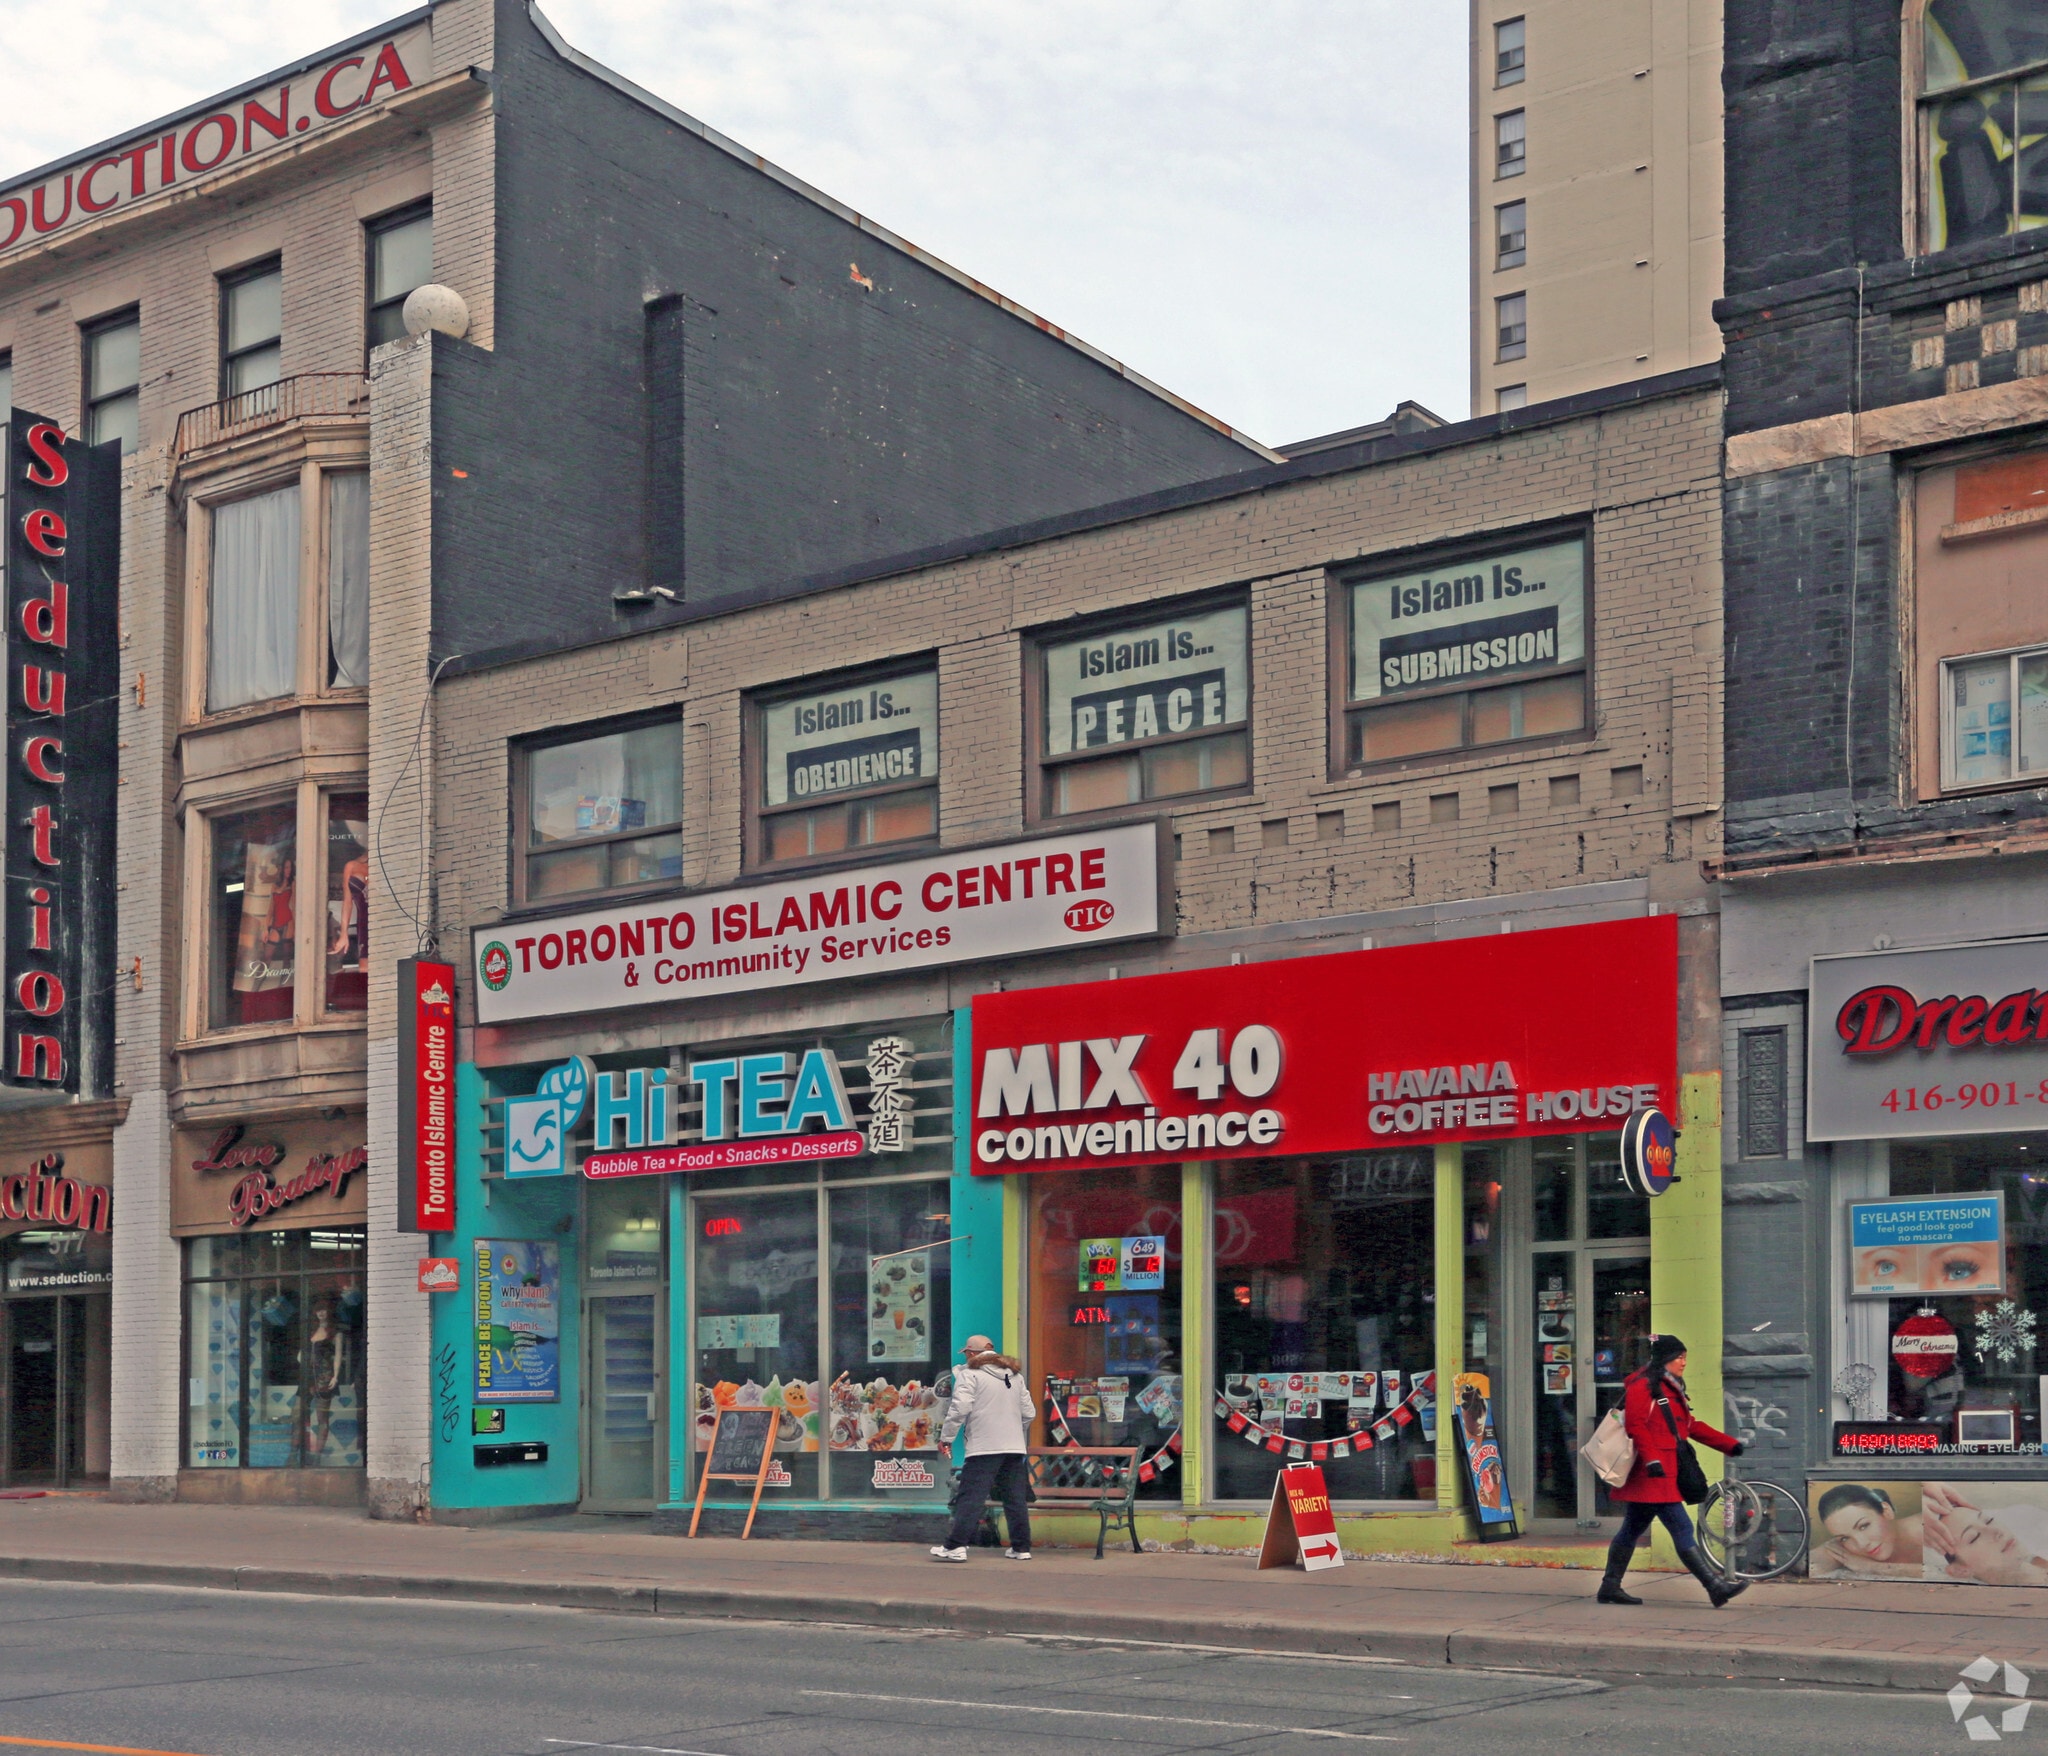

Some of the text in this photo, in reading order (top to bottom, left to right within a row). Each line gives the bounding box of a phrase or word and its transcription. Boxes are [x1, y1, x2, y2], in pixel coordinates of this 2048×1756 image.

[1391, 564, 1546, 620] Islam Is...
[1080, 629, 1214, 680] Islam Is...
[1383, 627, 1554, 687] SUBMISSION
[794, 691, 910, 736] Islam Is...
[1076, 681, 1222, 750] PEACE
[17, 423, 68, 1081] Seduction
[794, 747, 914, 795] OBEDIENCE
[515, 912, 695, 973] TORONTO
[711, 880, 902, 945] ISLAMIC
[921, 848, 1106, 913] CENTRE
[624, 926, 951, 988] & Community Services
[977, 1024, 1283, 1118] MIX 40
[1368, 1061, 1516, 1101] HAVANA
[424, 1025, 446, 1215] Toronto Islamic Centre
[594, 1047, 850, 1150] Hi TEA
[1368, 1083, 1659, 1134] COFFEE HOUSE
[192, 1125, 277, 1170] Love
[591, 1138, 858, 1176] Bubble Tea Food Snacks Desserts
[977, 1107, 1283, 1163] convenience
[0, 1153, 110, 1233] ction
[706, 1217, 742, 1237] OPEN
[1860, 1208, 1991, 1225] EYELASH EXTENSION
[1877, 1221, 1974, 1233] feel good look good
[1913, 1233, 1952, 1241] mascara
[49, 1232, 86, 1255] 577
[1126, 1272, 1159, 1280] MILLION
[479, 1249, 492, 1387] PEACE BE UPON YOU
[511, 1321, 530, 1330] Islam
[1074, 1307, 1111, 1323] ATM
[903, 1462, 922, 1470] cook
[1842, 1443, 2043, 1454] NAILS FACIAL WAXING EYELASH
[875, 1471, 899, 1482] JUST
[1291, 1496, 1328, 1514] VARIETY
